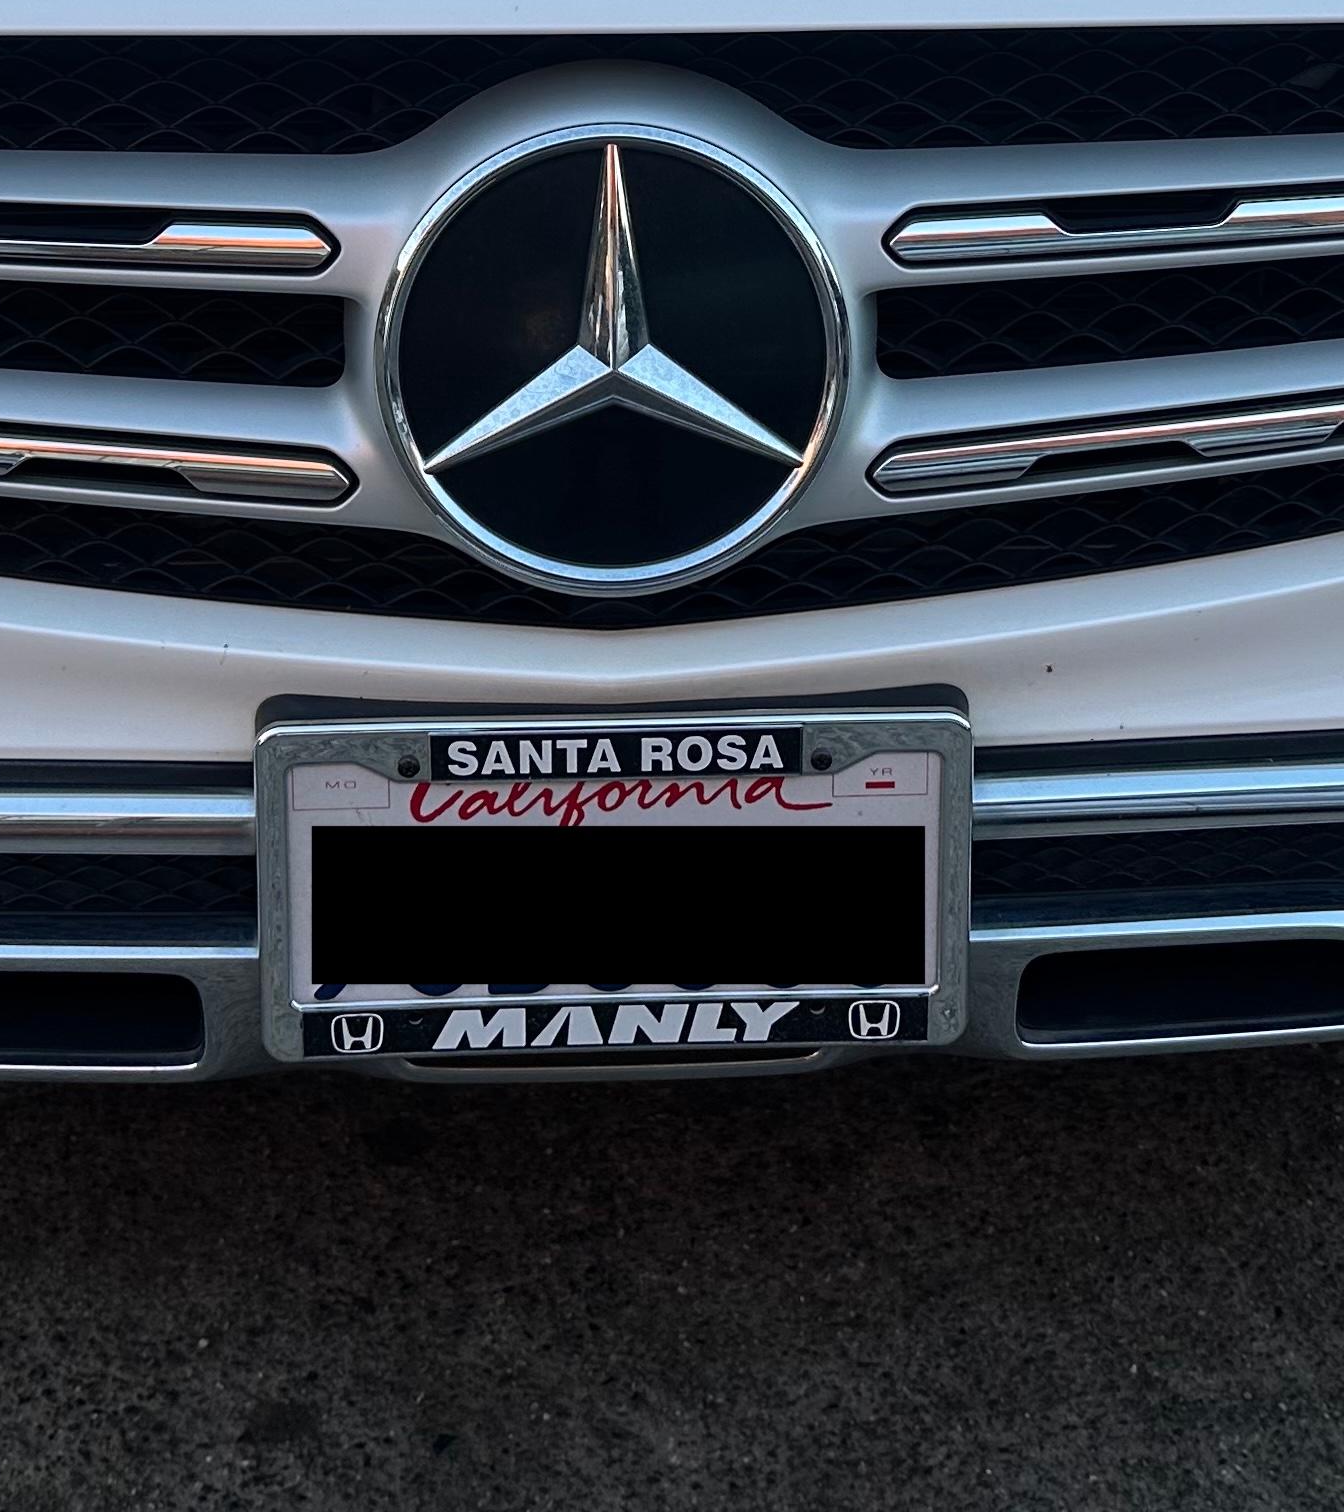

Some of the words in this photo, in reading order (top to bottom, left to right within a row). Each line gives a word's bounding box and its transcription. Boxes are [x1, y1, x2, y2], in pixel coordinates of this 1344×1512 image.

[447, 738, 622, 776] SANTA
[640, 734, 784, 773] ROSA
[325, 779, 358, 789] MO
[869, 767, 894, 777] YR
[432, 1000, 801, 1051] MANLY
